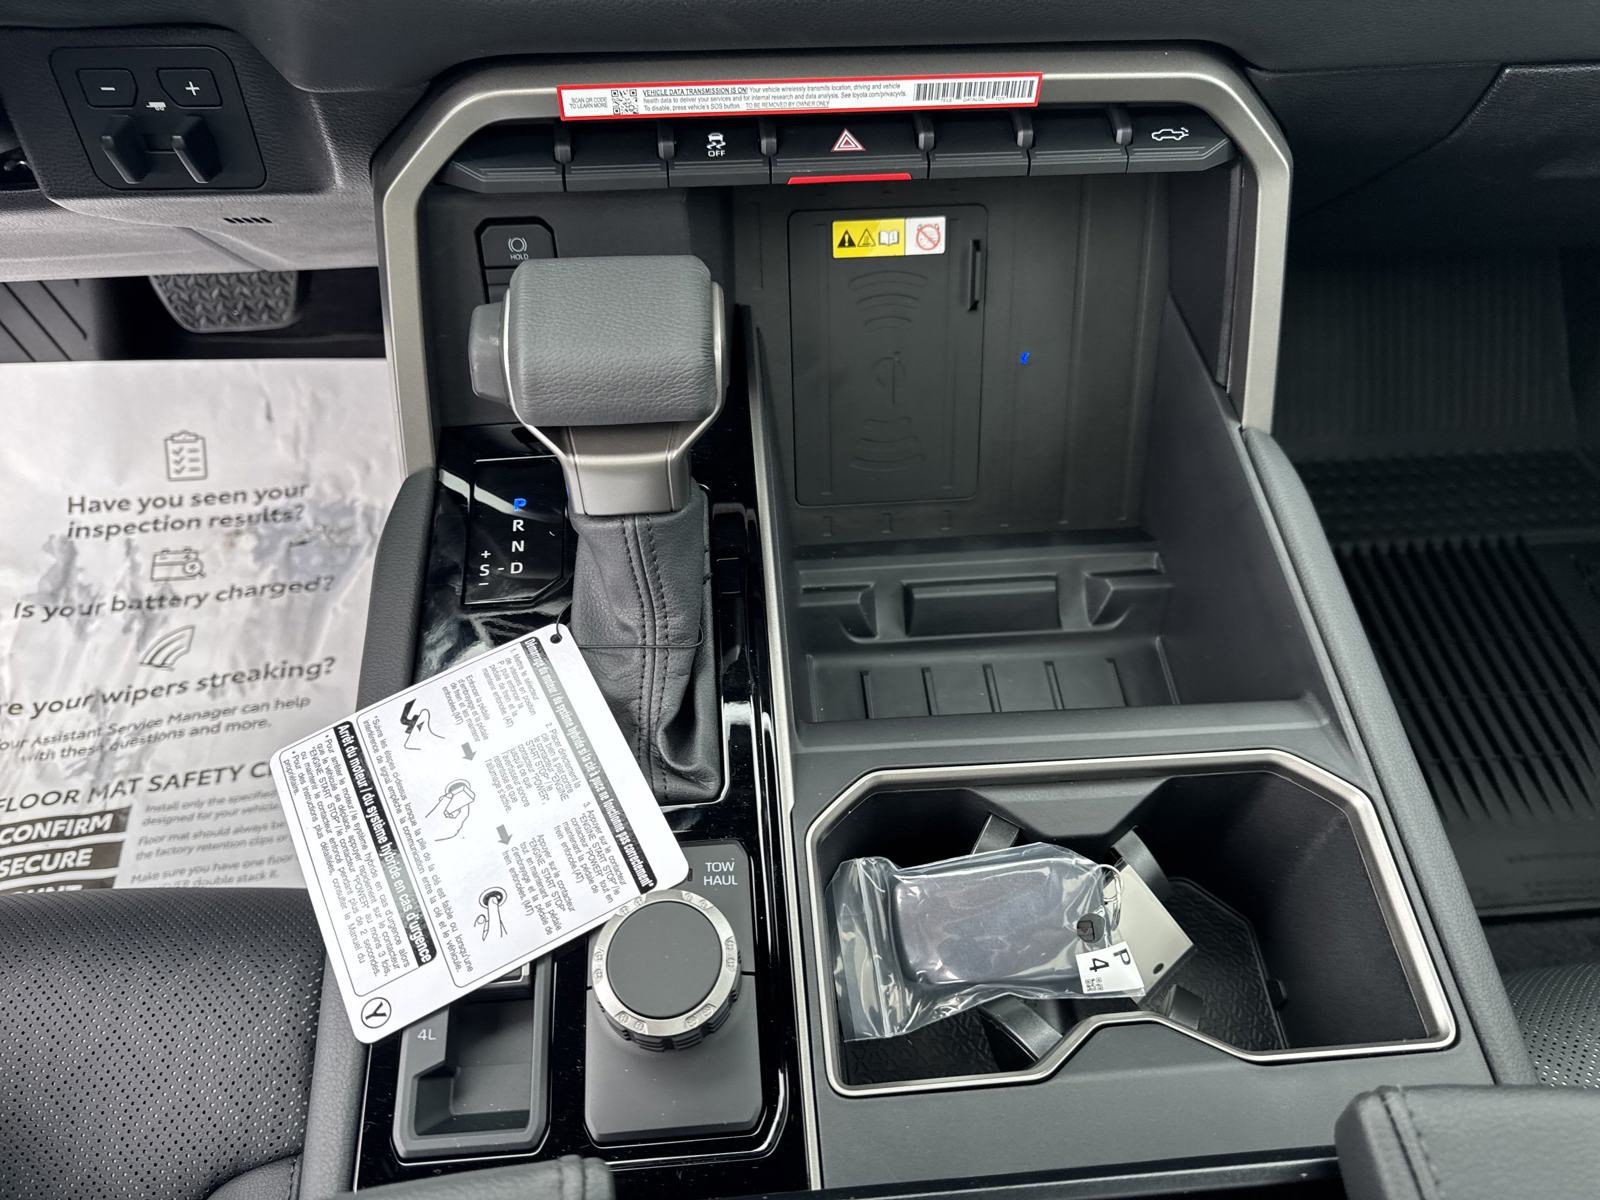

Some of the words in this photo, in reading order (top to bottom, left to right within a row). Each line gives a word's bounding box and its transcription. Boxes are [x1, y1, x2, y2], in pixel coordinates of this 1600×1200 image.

[642, 88, 667, 96] VEHICLE
[685, 87, 728, 95] TRANSMISSION
[68, 496, 129, 514] Have
[137, 497, 183, 516] you
[191, 489, 247, 507] seen
[253, 482, 309, 503] your
[513, 498, 527, 512] P
[67, 515, 201, 541] inspection
[208, 505, 305, 527] results?
[512, 520, 525, 532] R
[512, 540, 524, 552] N
[479, 564, 490, 576] S
[510, 562, 523, 574] D
[13, 602, 34, 619] Is
[41, 601, 104, 622] your
[111, 591, 208, 616] battery
[215, 576, 335, 601] charged?
[30, 696, 94, 719] your
[101, 680, 189, 708] wipers
[196, 657, 337, 692] streaking?
[107, 717, 164, 736] Service
[168, 706, 239, 731] Manager
[242, 700, 272, 715] can
[272, 694, 311, 713] help
[109, 728, 188, 751] questions
[189, 721, 221, 736] and
[225, 716, 272, 732] more.
[0, 789, 79, 813] FLOOR
[88, 776, 142, 801] MAT
[147, 762, 246, 793] SAFETY
[250, 761, 272, 779] C
[0, 813, 112, 844] CONFIRM
[338, 724, 354, 746] Arrêt
[349, 757, 367, 787] moteur
[366, 805, 387, 843] système
[380, 842, 401, 878] hybride
[399, 893, 412, 911] cas
[406, 912, 431, 962] d'urgence
[0, 848, 93, 878] SECURE
[292, 754, 301, 769] Pour
[313, 824, 323, 839] plus
[332, 878, 347, 909] consulter
[348, 923, 362, 950] Manuel
[313, 743, 324, 755] que
[348, 834, 361, 861] appuyer
[373, 907, 381, 917] sur
[382, 931, 400, 968] contacteur
[317, 800, 332, 833] contacteur
[337, 866, 352, 894] pendant
[349, 898, 358, 913] plus
[318, 776, 331, 798] START
[339, 838, 355, 872] contacteur
[371, 926, 381, 948] moins
[325, 738, 334, 753] Pour
[331, 756, 341, 775] arrêter
[353, 822, 367, 849] système
[364, 852, 377, 877] hybride
[379, 894, 387, 907] cas
[398, 949, 409, 967] alors
[704, 862, 735, 873] TOW
[704, 874, 738, 886] HAUL
[1089, 958, 1109, 972] 4
[1113, 948, 1131, 965] P
[417, 1031, 436, 1041] 4L
